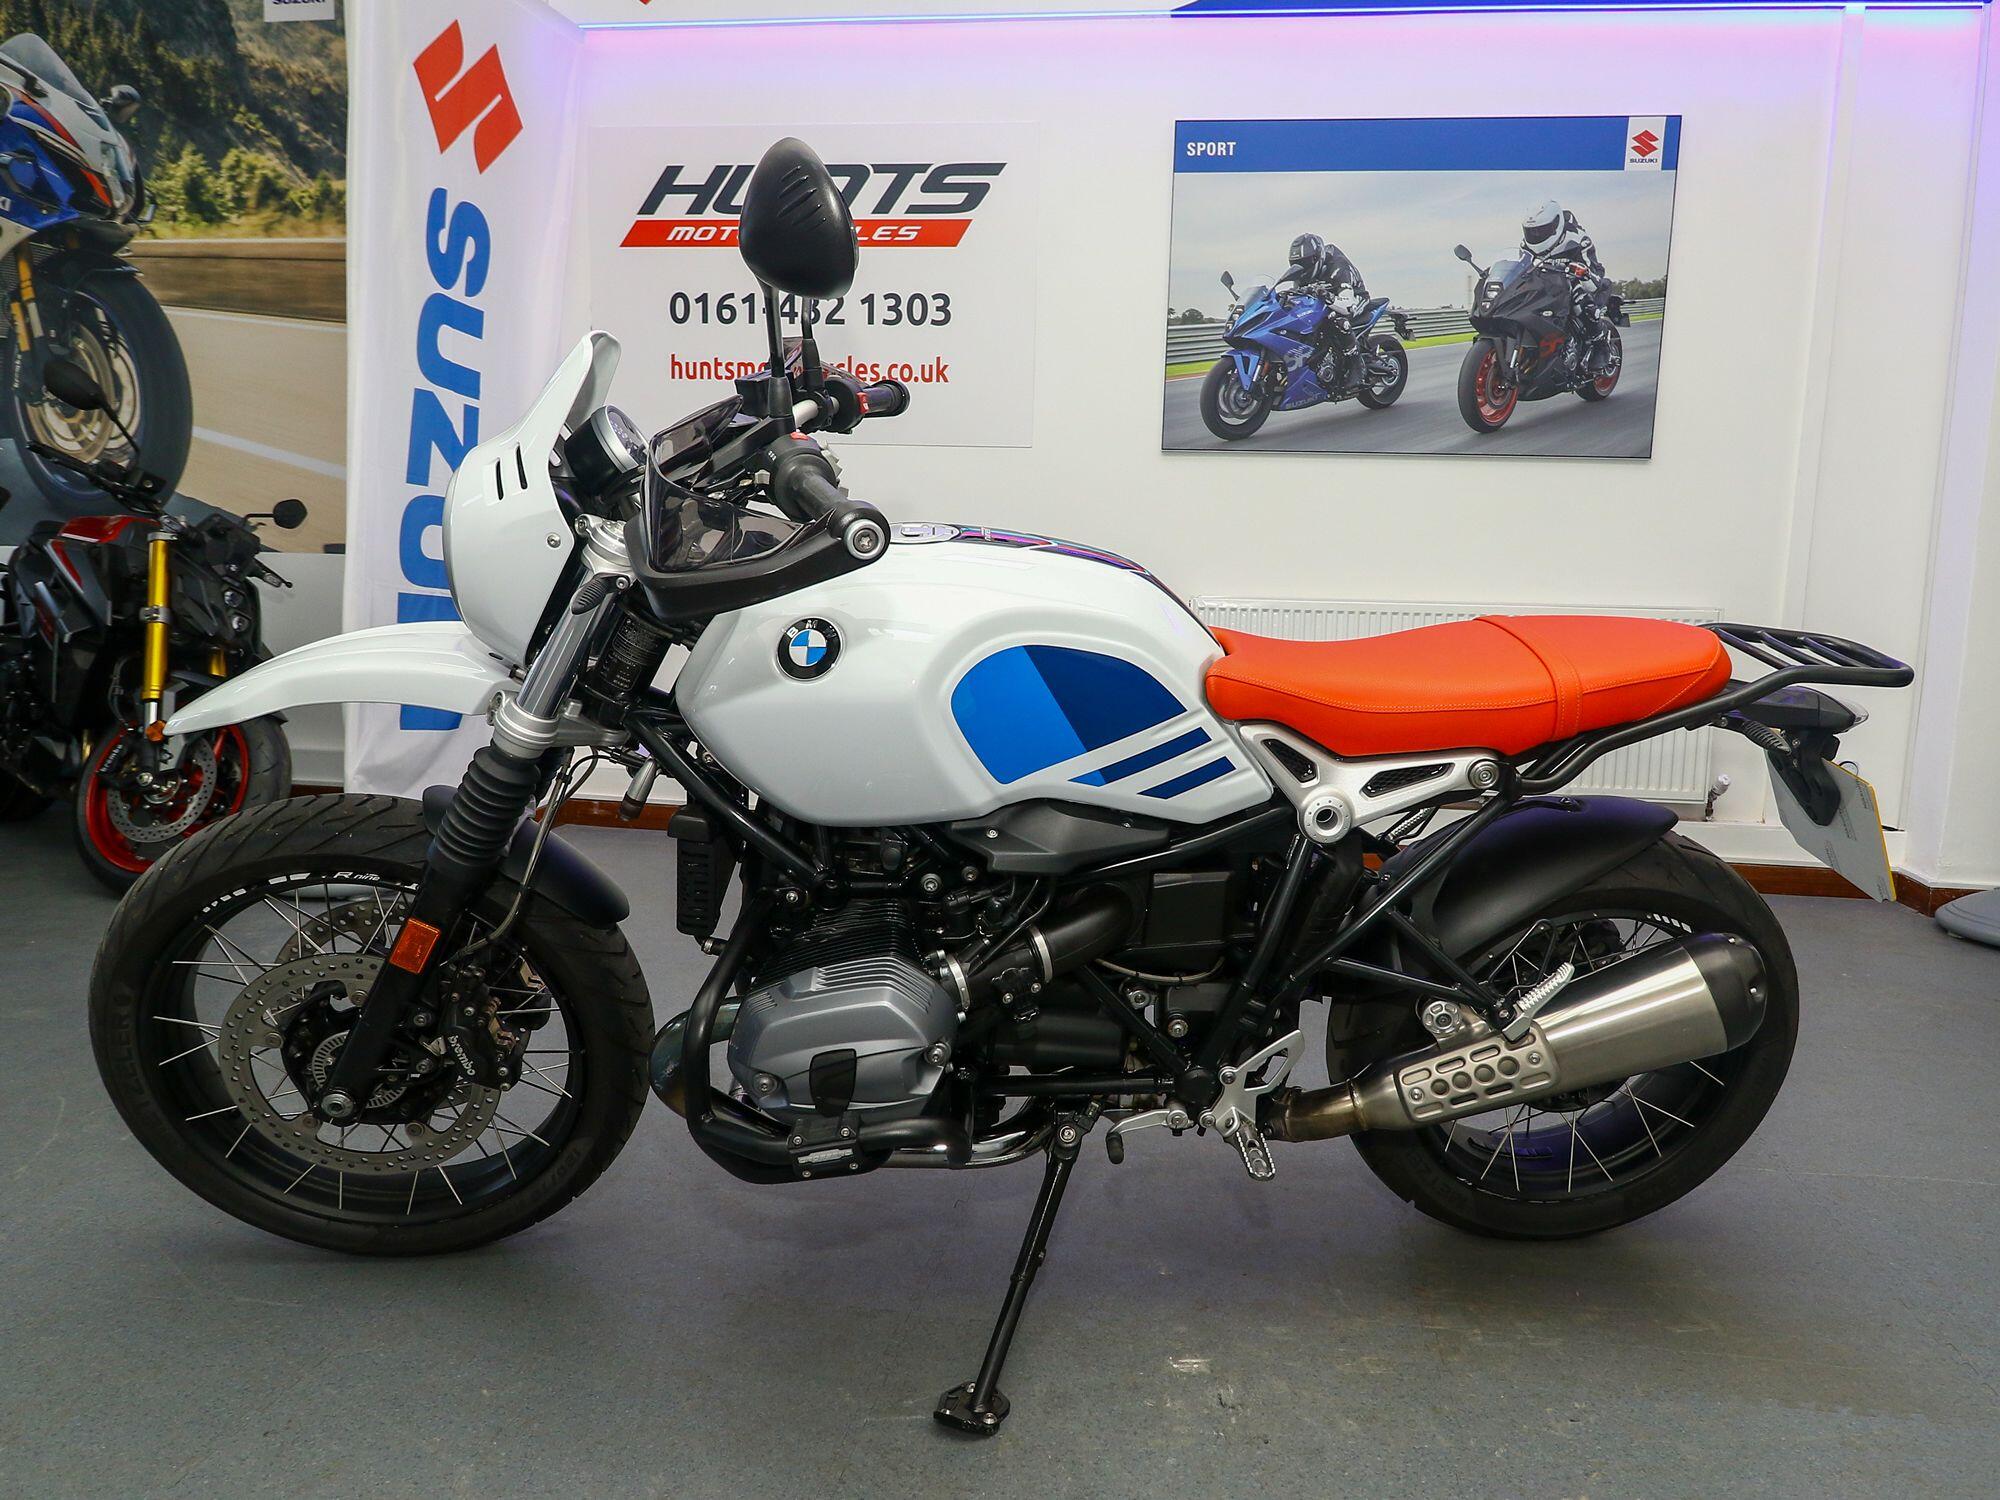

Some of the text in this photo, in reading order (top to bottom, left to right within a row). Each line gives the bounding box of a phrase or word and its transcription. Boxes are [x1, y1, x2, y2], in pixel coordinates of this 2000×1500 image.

[1187, 142, 1236, 156] SPORT
[666, 226, 922, 241] MOTLES
[860, 293, 952, 326] 1303
[447, 1034, 476, 1076] brembo
